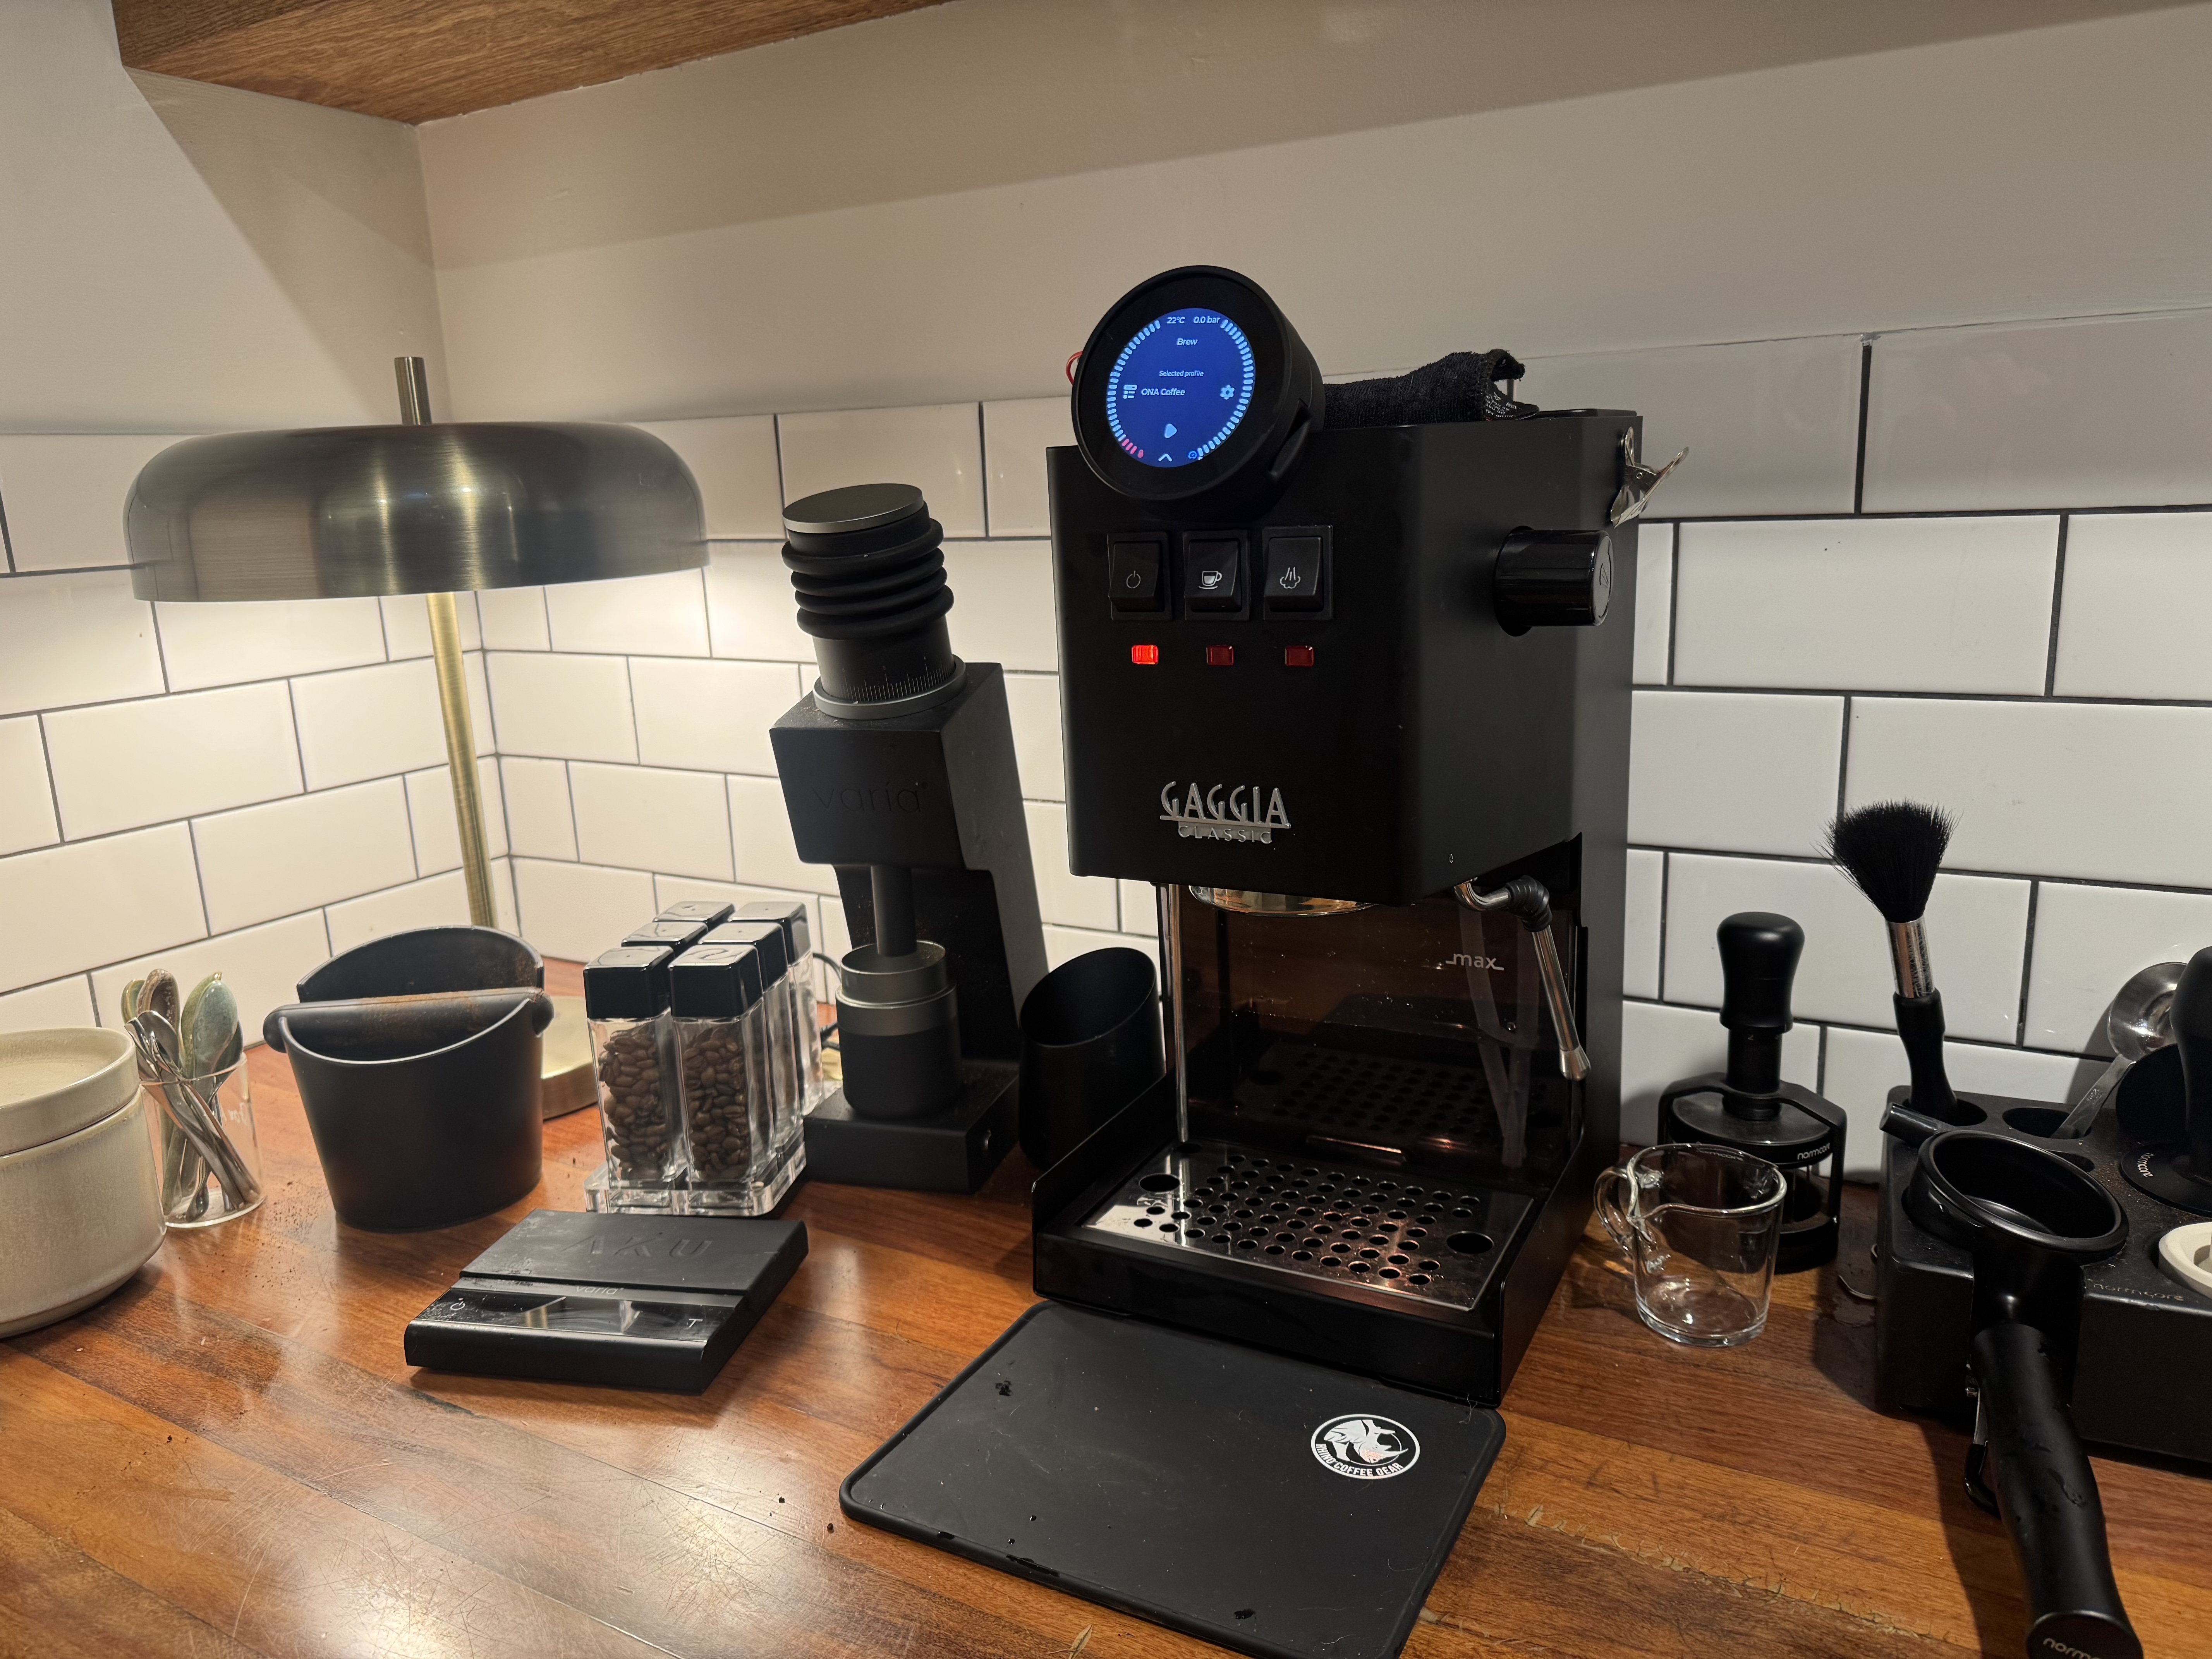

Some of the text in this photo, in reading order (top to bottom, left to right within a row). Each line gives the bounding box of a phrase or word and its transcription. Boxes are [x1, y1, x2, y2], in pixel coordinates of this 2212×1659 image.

[1207, 316, 1221, 324] bar
[812, 781, 921, 813] varia
[1161, 781, 1291, 829] GAGGIA
[1178, 825, 1273, 844] CLASSIC
[1453, 953, 1497, 969] max
[1797, 1142, 1831, 1160] normcore
[2136, 1152, 2154, 1177] normcore
[560, 1231, 713, 1257] AKU
[576, 1286, 618, 1295] varia
[1316, 1444, 1403, 1477] RHINO COFFEE GEAR
[2043, 1638, 2103, 1659] norm
